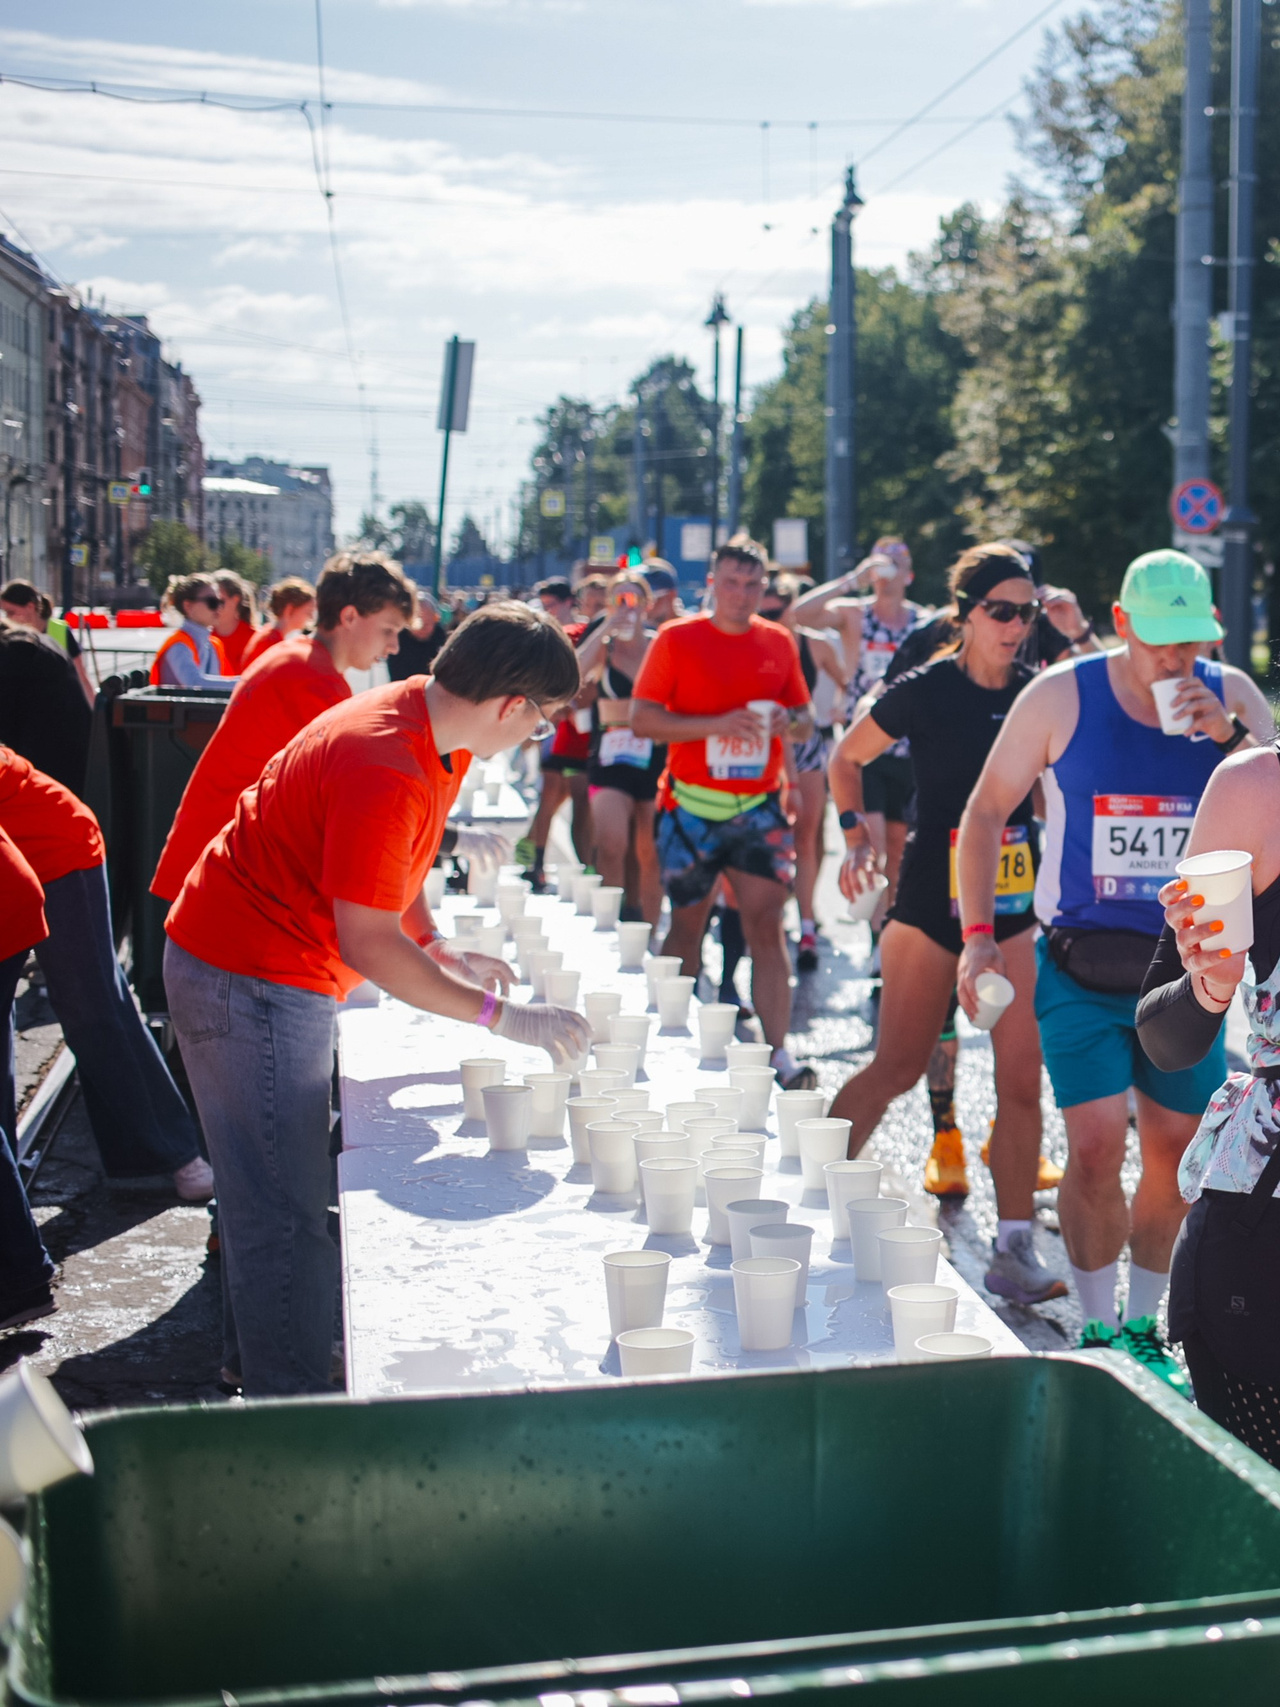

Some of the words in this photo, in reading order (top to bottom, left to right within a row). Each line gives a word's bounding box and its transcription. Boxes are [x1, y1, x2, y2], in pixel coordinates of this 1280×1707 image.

[1109, 826, 1190, 857] 5417
[1128, 861, 1170, 869] ANDREY
[1103, 877, 1117, 896] D
